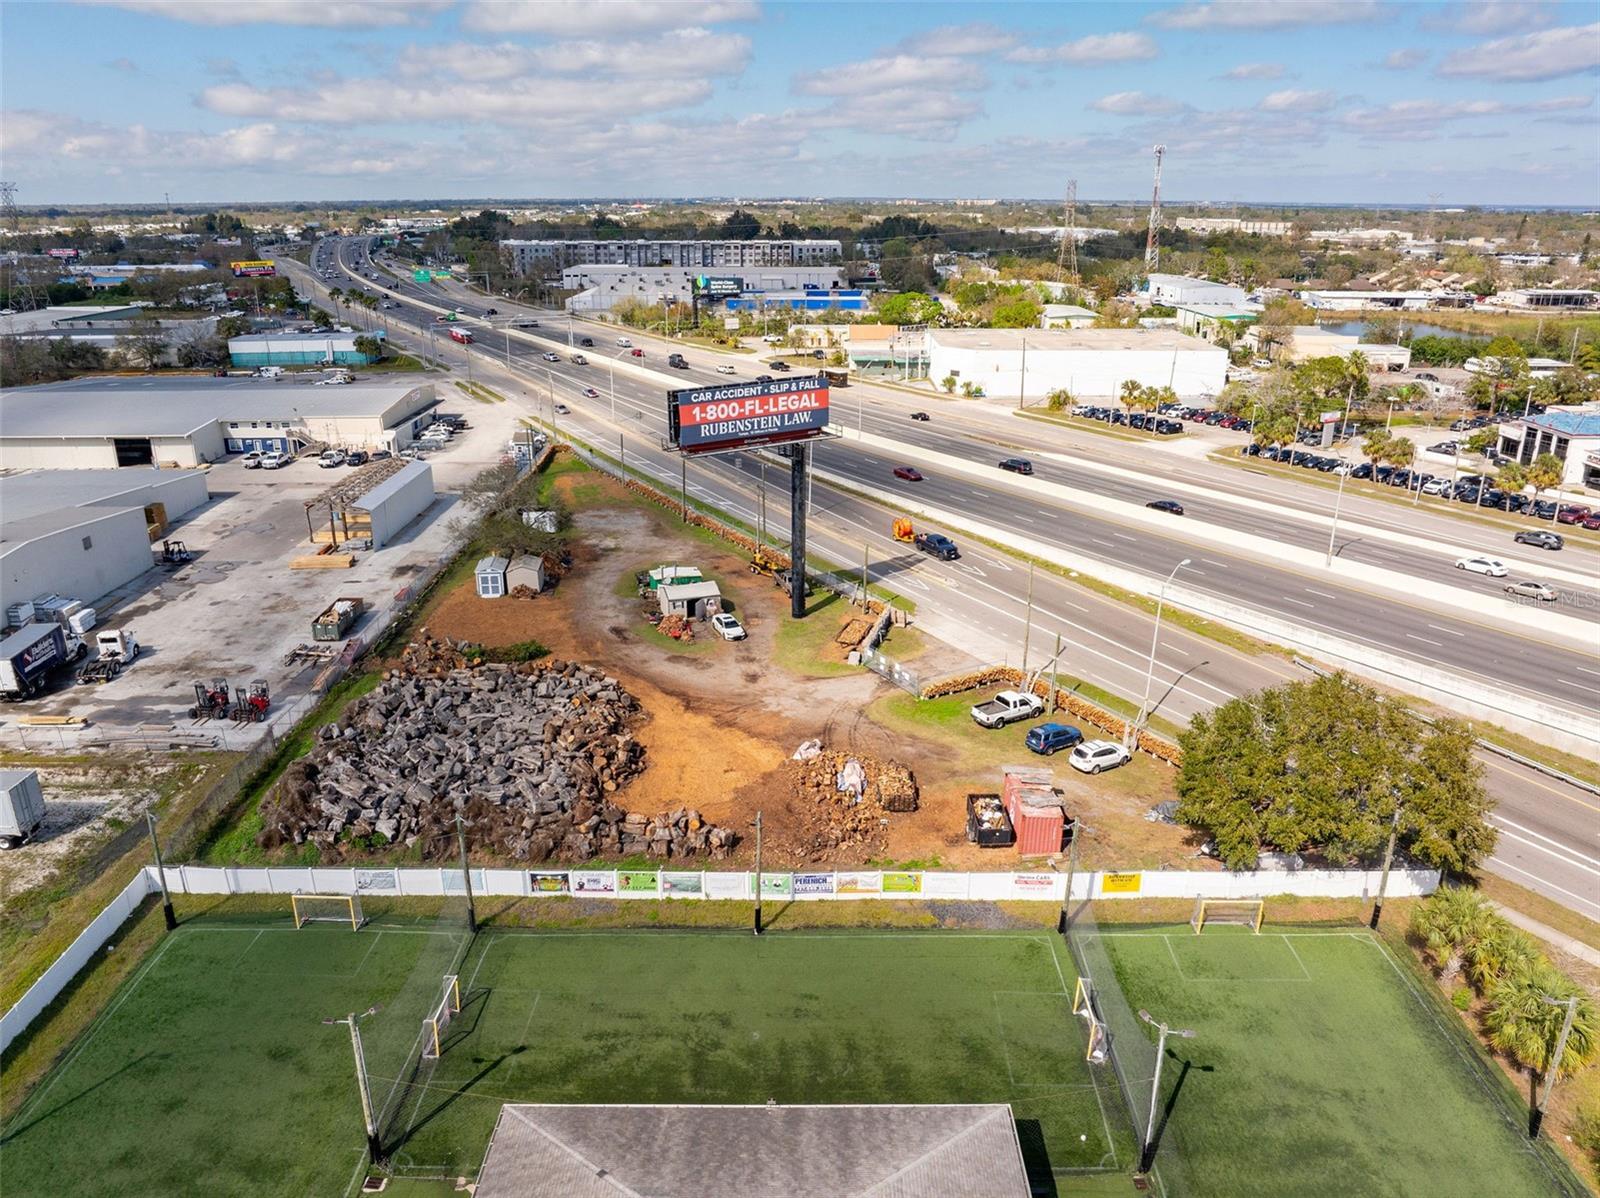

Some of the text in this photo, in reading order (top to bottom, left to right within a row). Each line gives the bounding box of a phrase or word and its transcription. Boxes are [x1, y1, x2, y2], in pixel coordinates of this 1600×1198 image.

[691, 380, 820, 402] CAR ACCIDENT SLIP & FALL
[692, 392, 820, 422] 1-800-FL-LEGAL
[700, 413, 781, 437] RUBENSTEIN
